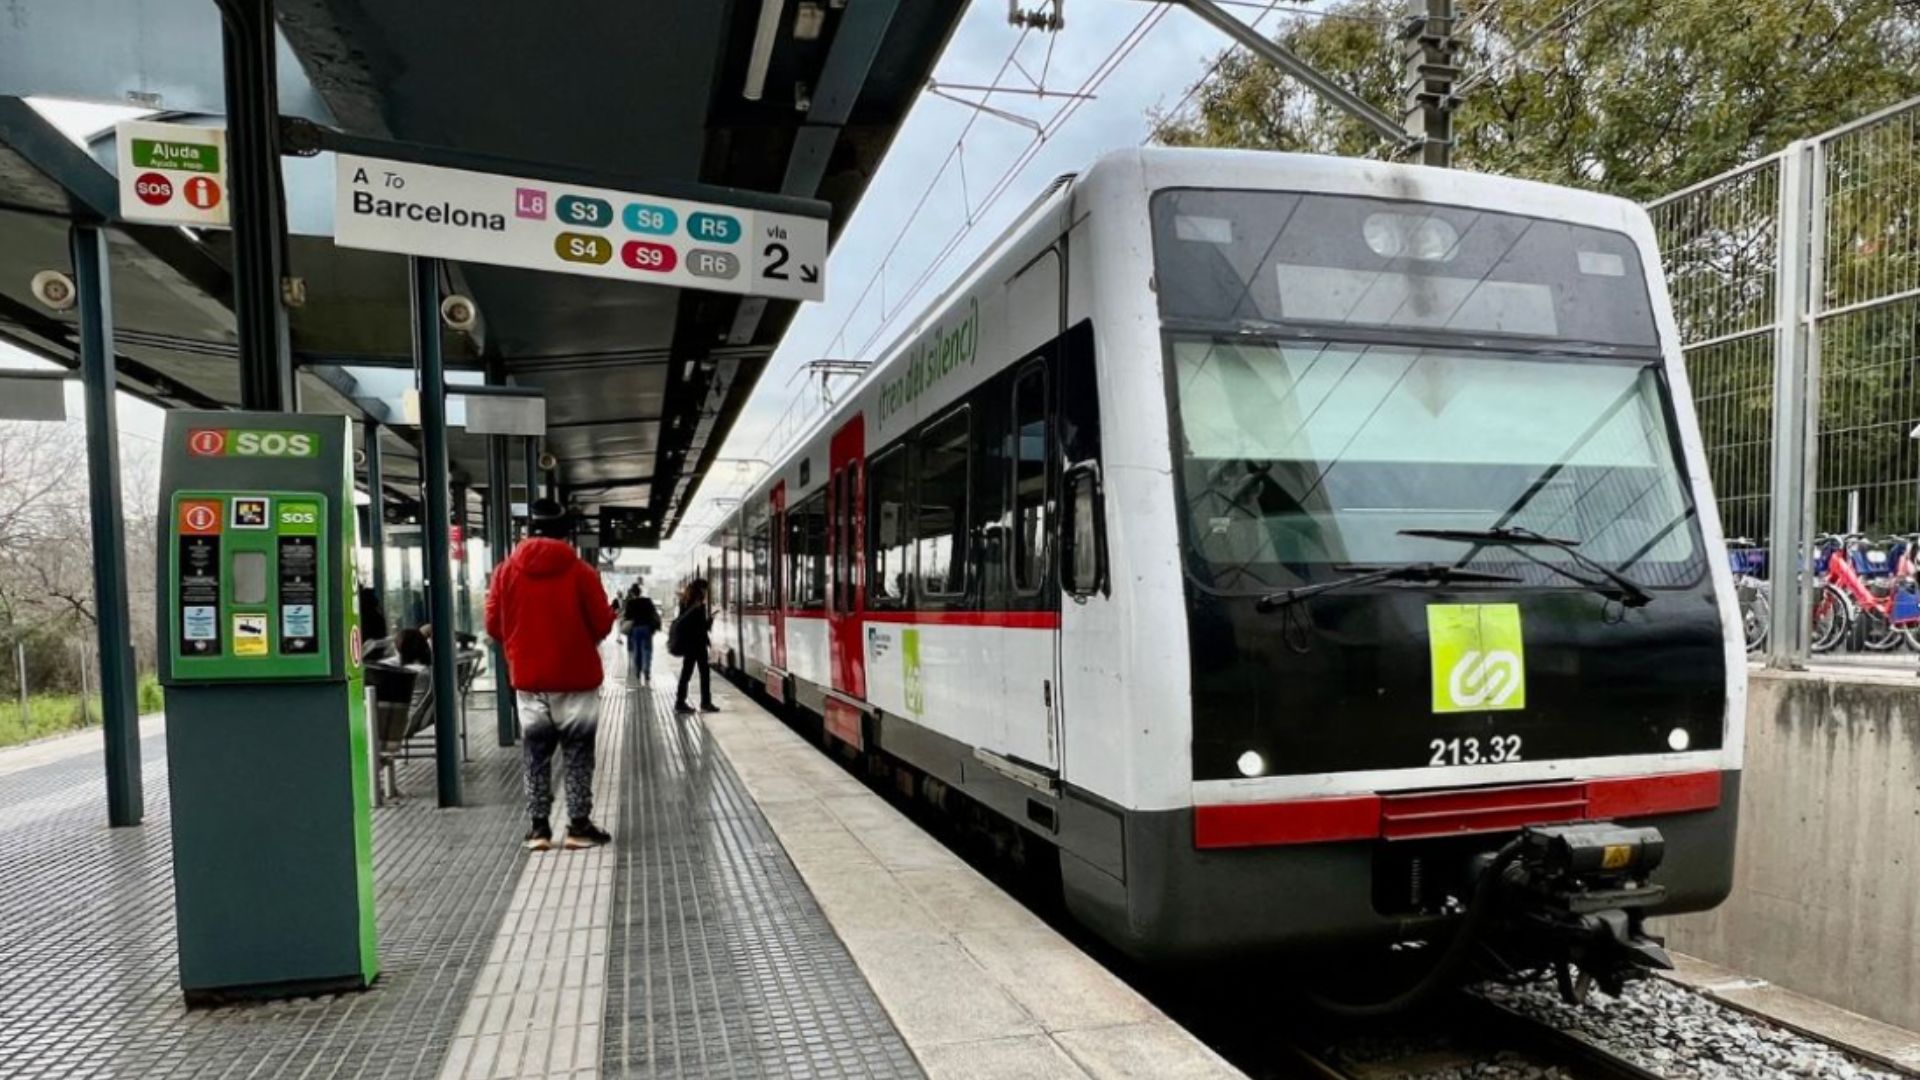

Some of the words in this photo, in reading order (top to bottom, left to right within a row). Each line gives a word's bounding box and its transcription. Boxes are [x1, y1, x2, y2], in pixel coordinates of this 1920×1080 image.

[152, 143, 200, 159] Ajuda
[138, 182, 171, 196] SOS
[353, 168, 369, 184] A
[384, 172, 405, 189] To
[353, 191, 506, 231] Barcelona
[518, 194, 545, 214] L8
[570, 201, 598, 221] S3
[637, 209, 664, 230] S8
[701, 217, 728, 237] R5
[570, 238, 598, 258] S4
[635, 246, 663, 266] S9
[700, 254, 727, 273] R6
[762, 243, 789, 280] 2
[236, 433, 311, 456] SOS
[281, 513, 315, 524] SOS
[1429, 734, 1522, 766] 213.32
